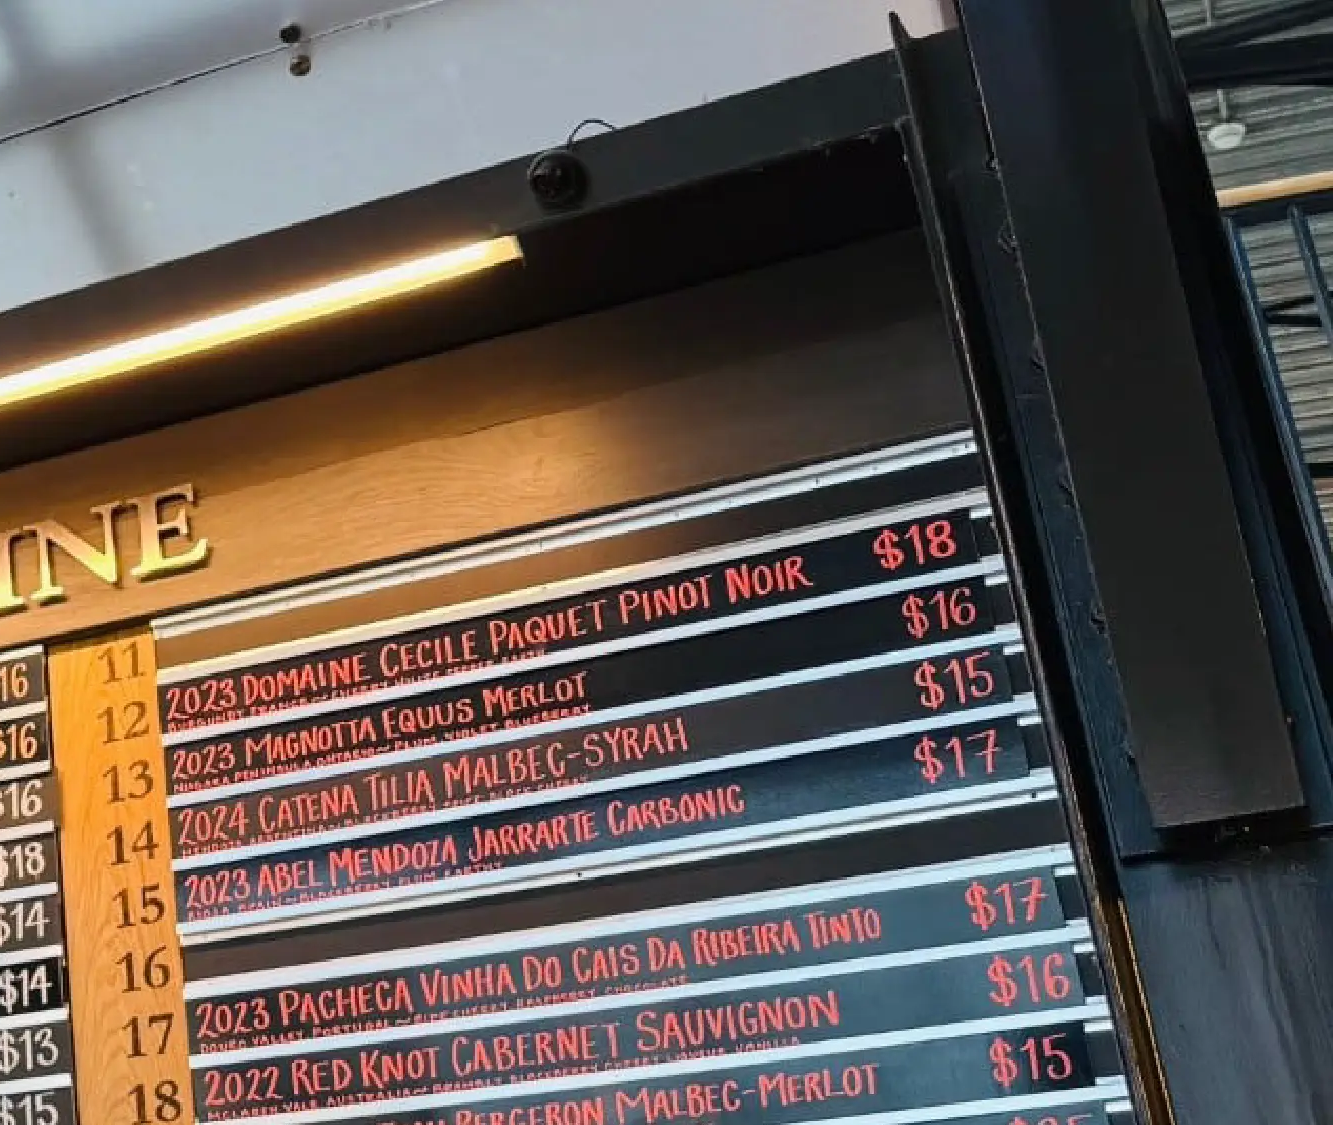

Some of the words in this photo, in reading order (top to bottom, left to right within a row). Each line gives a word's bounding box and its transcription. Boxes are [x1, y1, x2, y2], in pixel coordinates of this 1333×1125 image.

[166, 678, 236, 721] 2023
[244, 651, 372, 705] DOMAINE
[379, 630, 478, 677] CECILE
[489, 599, 607, 654] PAQUET
[619, 574, 712, 624] PINOT
[724, 555, 814, 605] NOIR
[873, 520, 956, 570] $18
[98, 642, 147, 685] 11
[173, 743, 235, 780] 2023
[246, 715, 377, 766] MAGNOTTA
[384, 698, 474, 740] EQUUS
[483, 670, 588, 718] MERLOT
[902, 587, 977, 638] $16
[97, 700, 150, 745] 12
[179, 802, 248, 846] 2024
[257, 785, 359, 832] CATENA
[362, 769, 434, 810] TILIA
[442, 717, 690, 797] MALBEC-SYRAH
[914, 652, 994, 709] $15
[102, 759, 154, 803] 13
[106, 820, 158, 865] 14
[185, 868, 250, 908] 2023
[258, 859, 323, 897] ABEL
[329, 835, 457, 887] MENDOZA
[469, 811, 599, 861] JARRARTE
[606, 785, 746, 836] CARBONIC
[914, 728, 1002, 784] $17
[112, 883, 165, 929] 15
[114, 945, 170, 994] 16
[195, 997, 270, 1038] 2023
[279, 977, 414, 1025] PACHECA
[420, 962, 517, 1007] VINHA
[522, 956, 562, 992] DO
[571, 944, 640, 983] CAIS
[647, 937, 685, 971] DA
[692, 919, 801, 967] RIBEIRA
[803, 907, 882, 949] TINTO
[964, 876, 1049, 931] $17
[122, 1013, 174, 1058] 17
[204, 1066, 283, 1105] 2022
[291, 1056, 352, 1095] RED
[359, 1046, 440, 1091] KNOT
[451, 1021, 621, 1076] CABERNET
[636, 990, 840, 1051] SAUVIGNON
[986, 953, 1070, 1007] $16
[127, 1080, 181, 1125] 18
[615, 1064, 878, 1125] MALBEC-MERLOT
[989, 1033, 1073, 1088] $15
